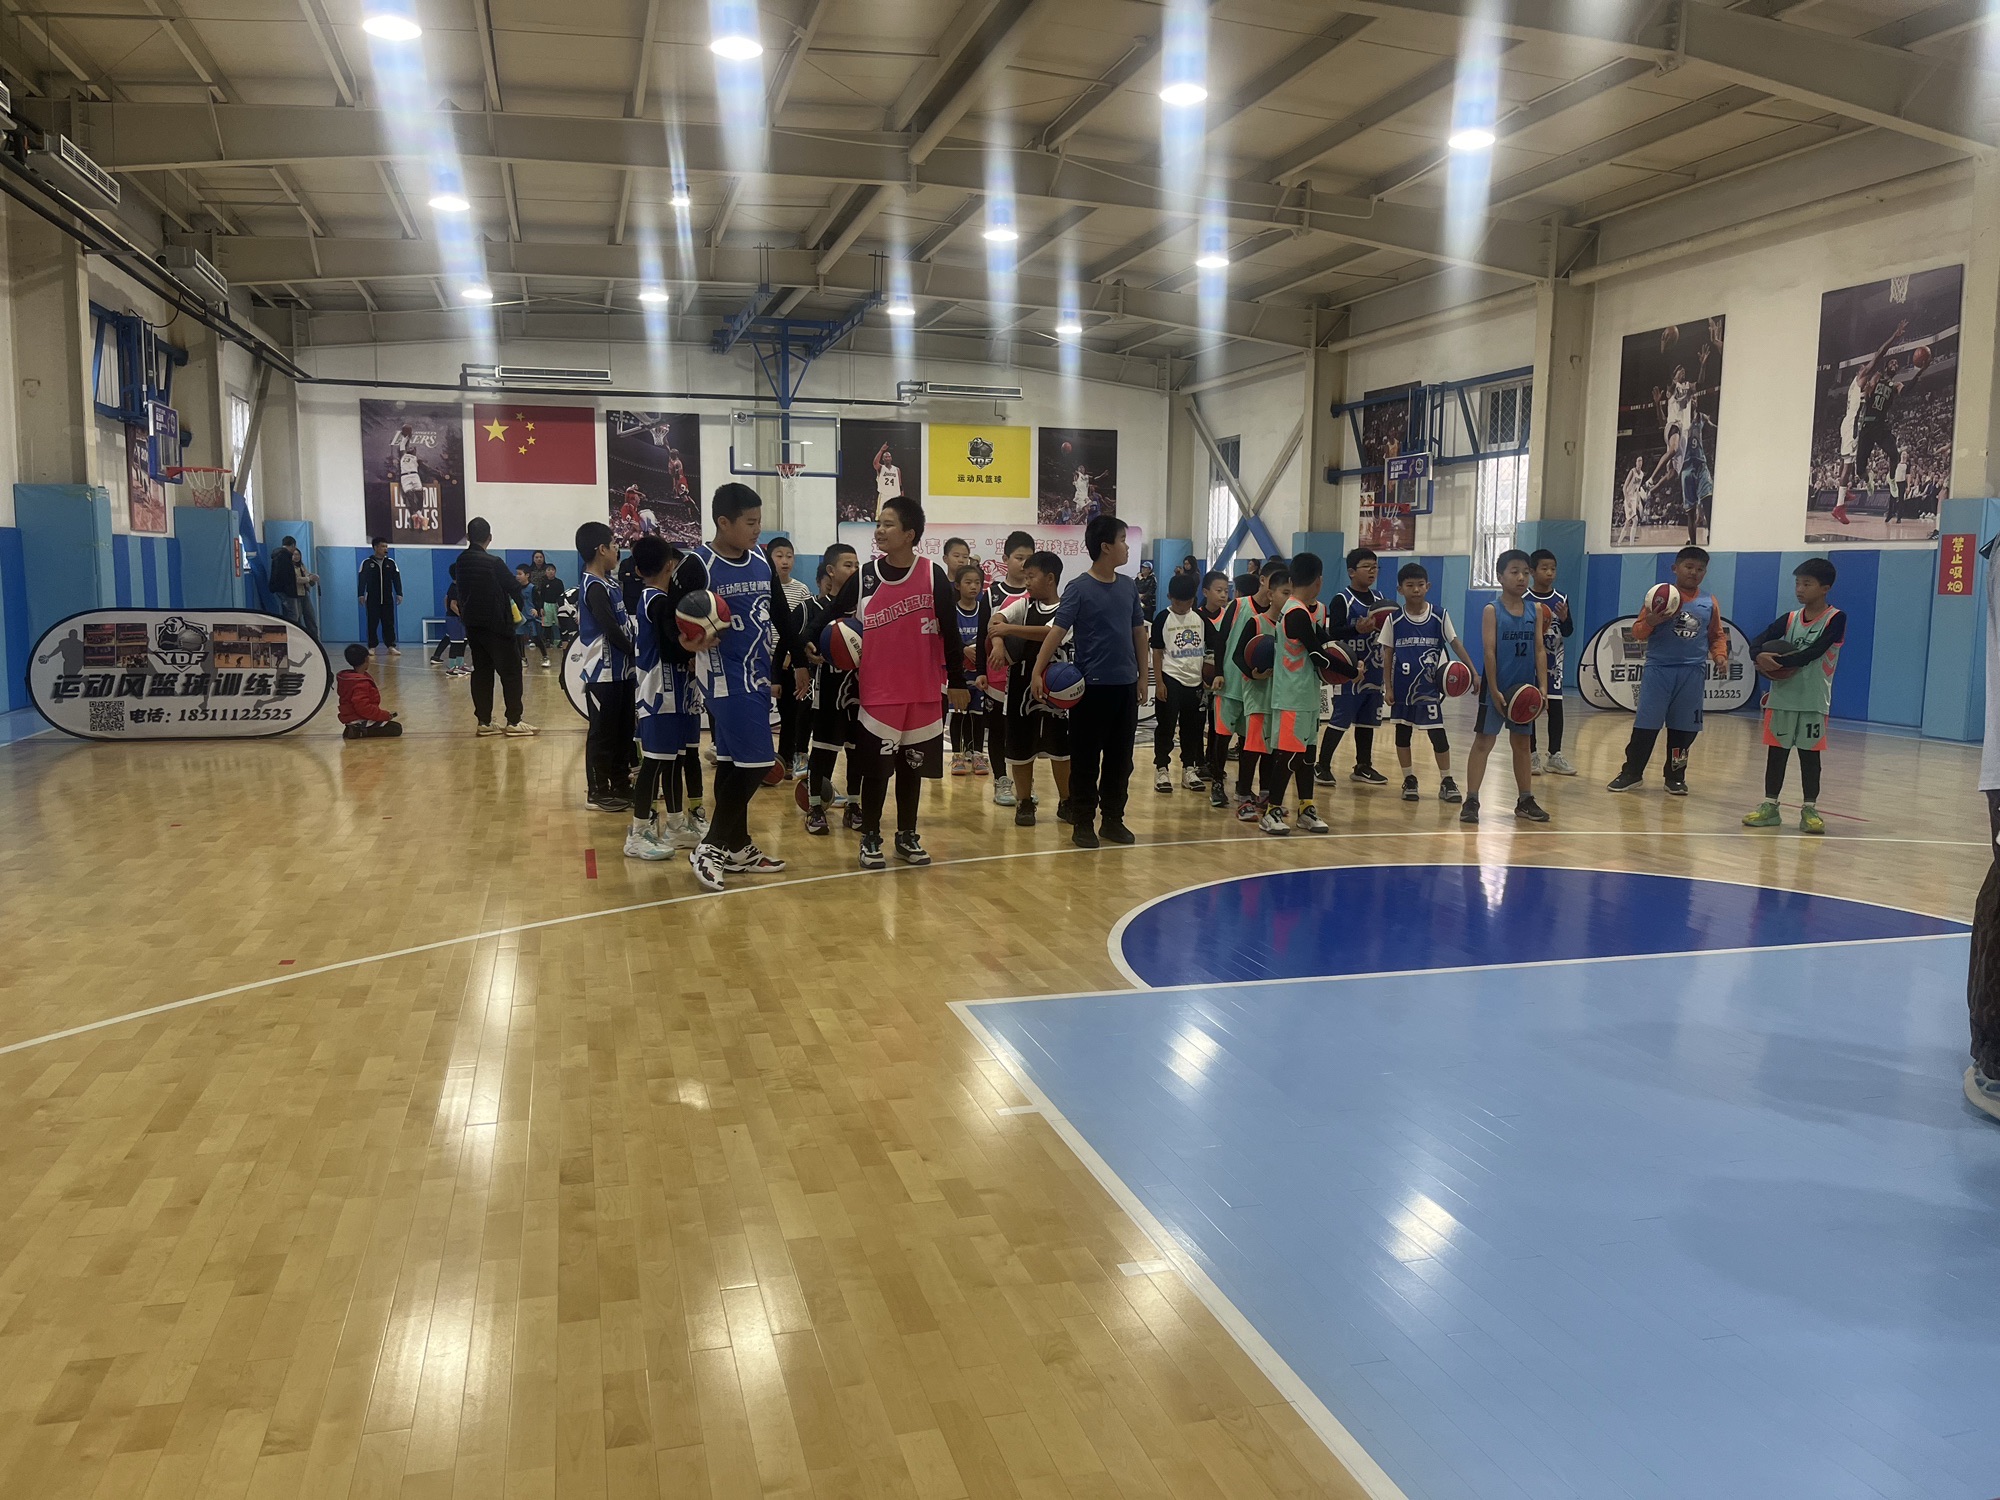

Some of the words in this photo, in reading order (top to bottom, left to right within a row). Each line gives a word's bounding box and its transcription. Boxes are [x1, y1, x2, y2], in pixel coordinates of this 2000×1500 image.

[1691, 438, 1698, 449] 9
[885, 478, 894, 486] 24
[957, 474, 1003, 483] 运动风篮球
[1947, 536, 1964, 593] 禁止吸烟
[1674, 630, 1698, 638] YDF
[1348, 639, 1365, 651] 99
[1515, 642, 1527, 657] 12
[158, 651, 207, 665] YDF
[1402, 662, 1411, 675] 9
[51, 673, 306, 698] 运动风篮球训练营
[178, 708, 293, 722] 18511122525
[1427, 704, 1438, 720] 9
[1805, 723, 1820, 739] 13
